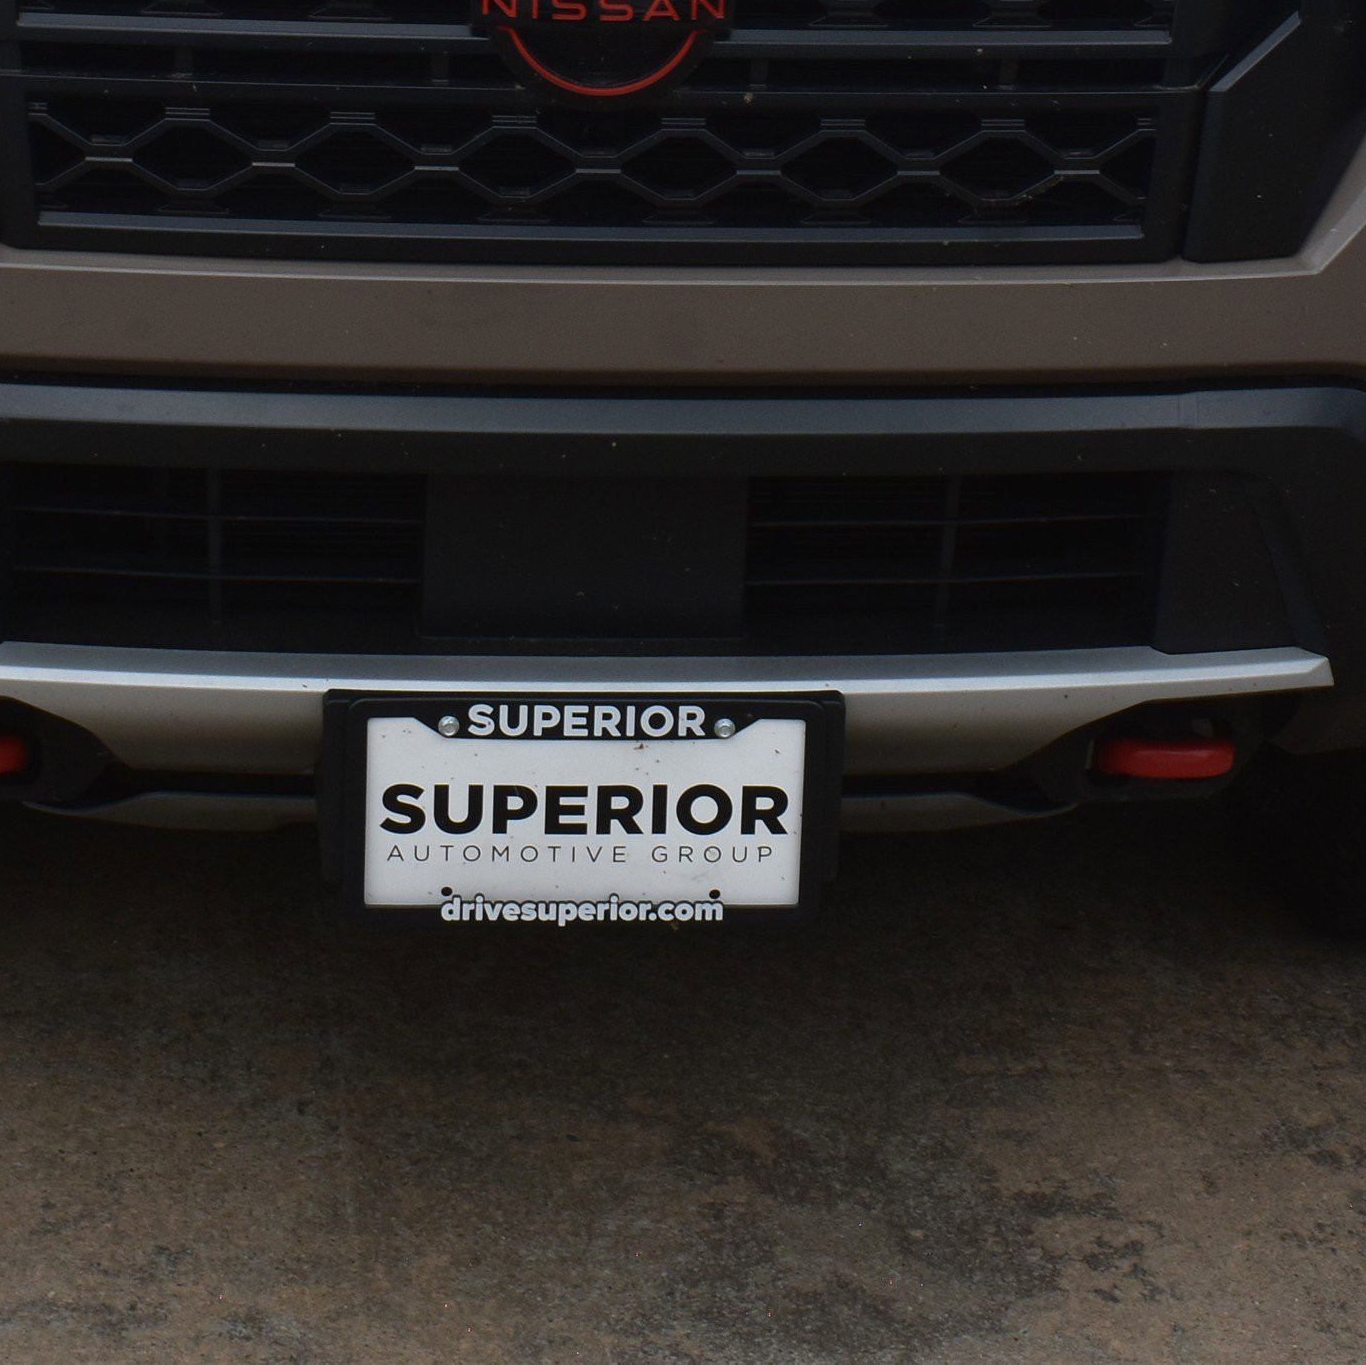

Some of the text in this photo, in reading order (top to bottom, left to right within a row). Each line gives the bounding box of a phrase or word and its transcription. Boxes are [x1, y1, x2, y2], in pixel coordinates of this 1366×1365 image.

[467, 705, 706, 737] SUPERIOR
[379, 784, 789, 835] SUPERIOR
[387, 845, 774, 863] AUTOMOTIVE GROUP
[440, 895, 724, 927] drivesuperior.com
